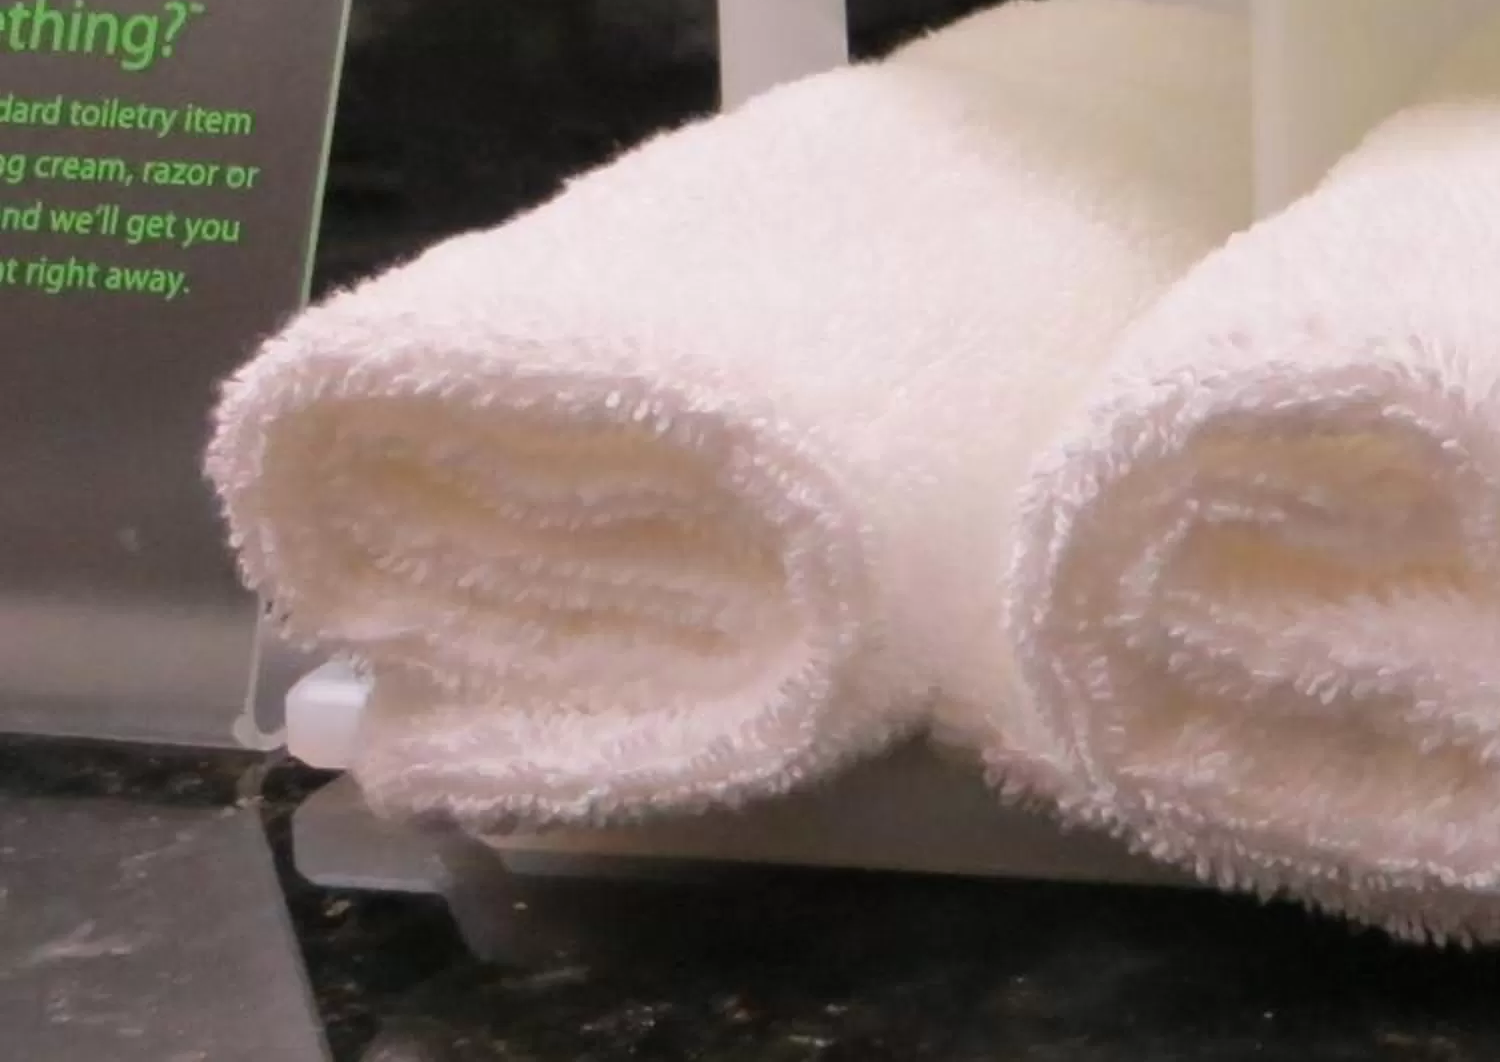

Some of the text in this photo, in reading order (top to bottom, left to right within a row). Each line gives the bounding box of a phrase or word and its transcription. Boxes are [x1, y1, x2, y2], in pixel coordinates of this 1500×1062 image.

[0, 91, 253, 138] dard toiletry item
[34, 154, 133, 187] cream,
[143, 162, 220, 187] razor
[226, 166, 260, 189] or
[51, 204, 120, 235] we'll
[127, 212, 177, 245] get
[182, 216, 241, 248] you
[26, 254, 99, 295] right
[104, 265, 191, 302] away.
